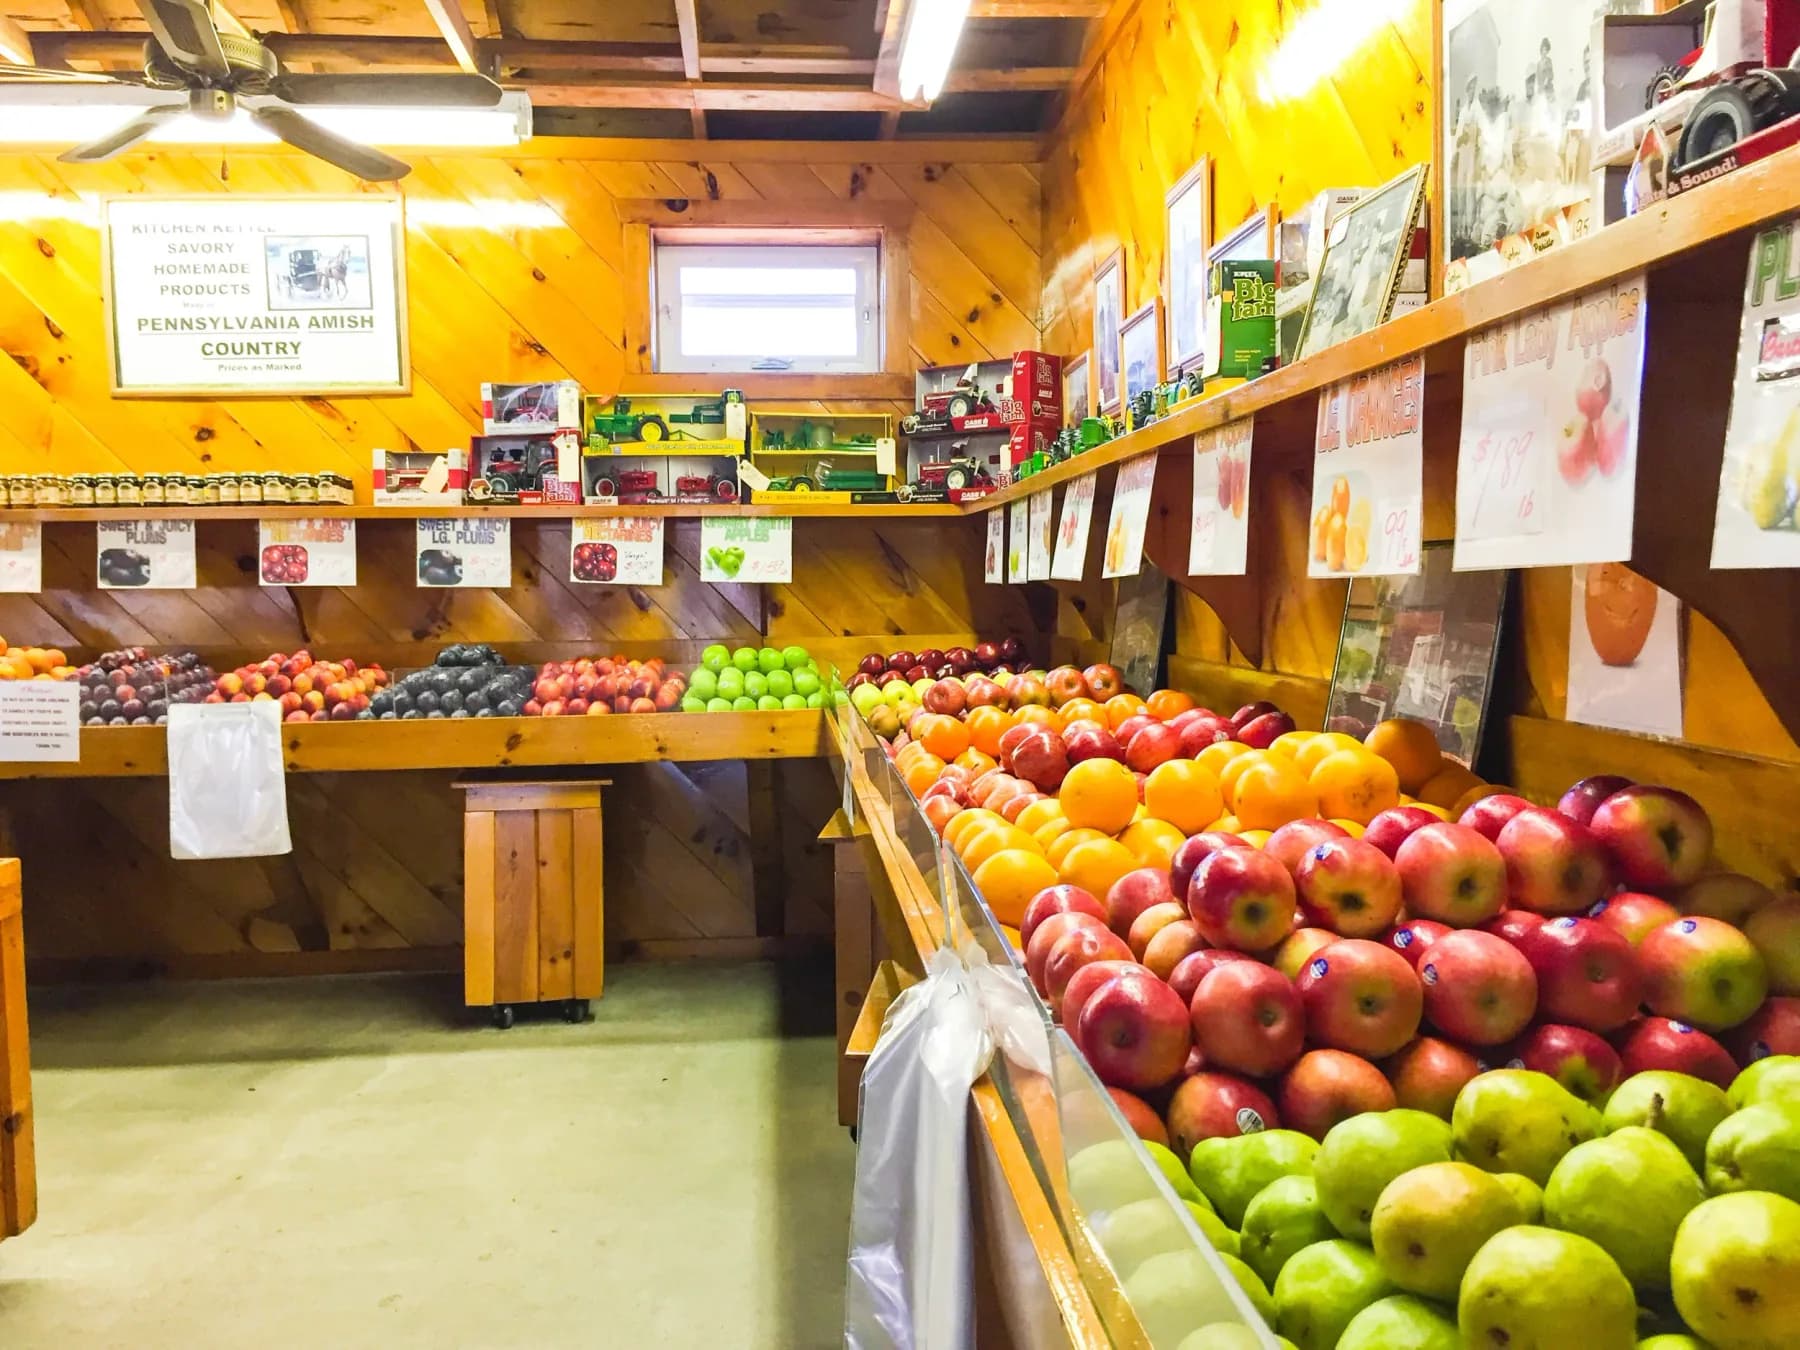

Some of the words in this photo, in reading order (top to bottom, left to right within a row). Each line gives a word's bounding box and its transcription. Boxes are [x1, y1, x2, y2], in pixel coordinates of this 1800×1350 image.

[1667, 182, 1681, 195] &
[1680, 156, 1738, 189] Sound!
[132, 224, 206, 234] KITCHEN
[167, 243, 235, 255] SAVORY
[154, 263, 250, 275] HOMEMADE
[160, 284, 251, 296] PRODUCTS
[137, 315, 300, 332] PENNSYLVANIA
[307, 314, 375, 330] AMISH
[1567, 283, 1641, 359] Apples
[201, 341, 302, 357] COUNTRY
[217, 363, 248, 371] Prices
[266, 363, 302, 371] Marked
[1000, 400, 1023, 415] Big
[964, 418, 981, 426] CASE
[419, 518, 457, 531] SWEET
[462, 519, 471, 531] &
[476, 518, 509, 532] JUICY
[126, 532, 167, 544] PLUMS
[432, 531, 451, 544] LG.
[456, 531, 495, 544] PLUMS
